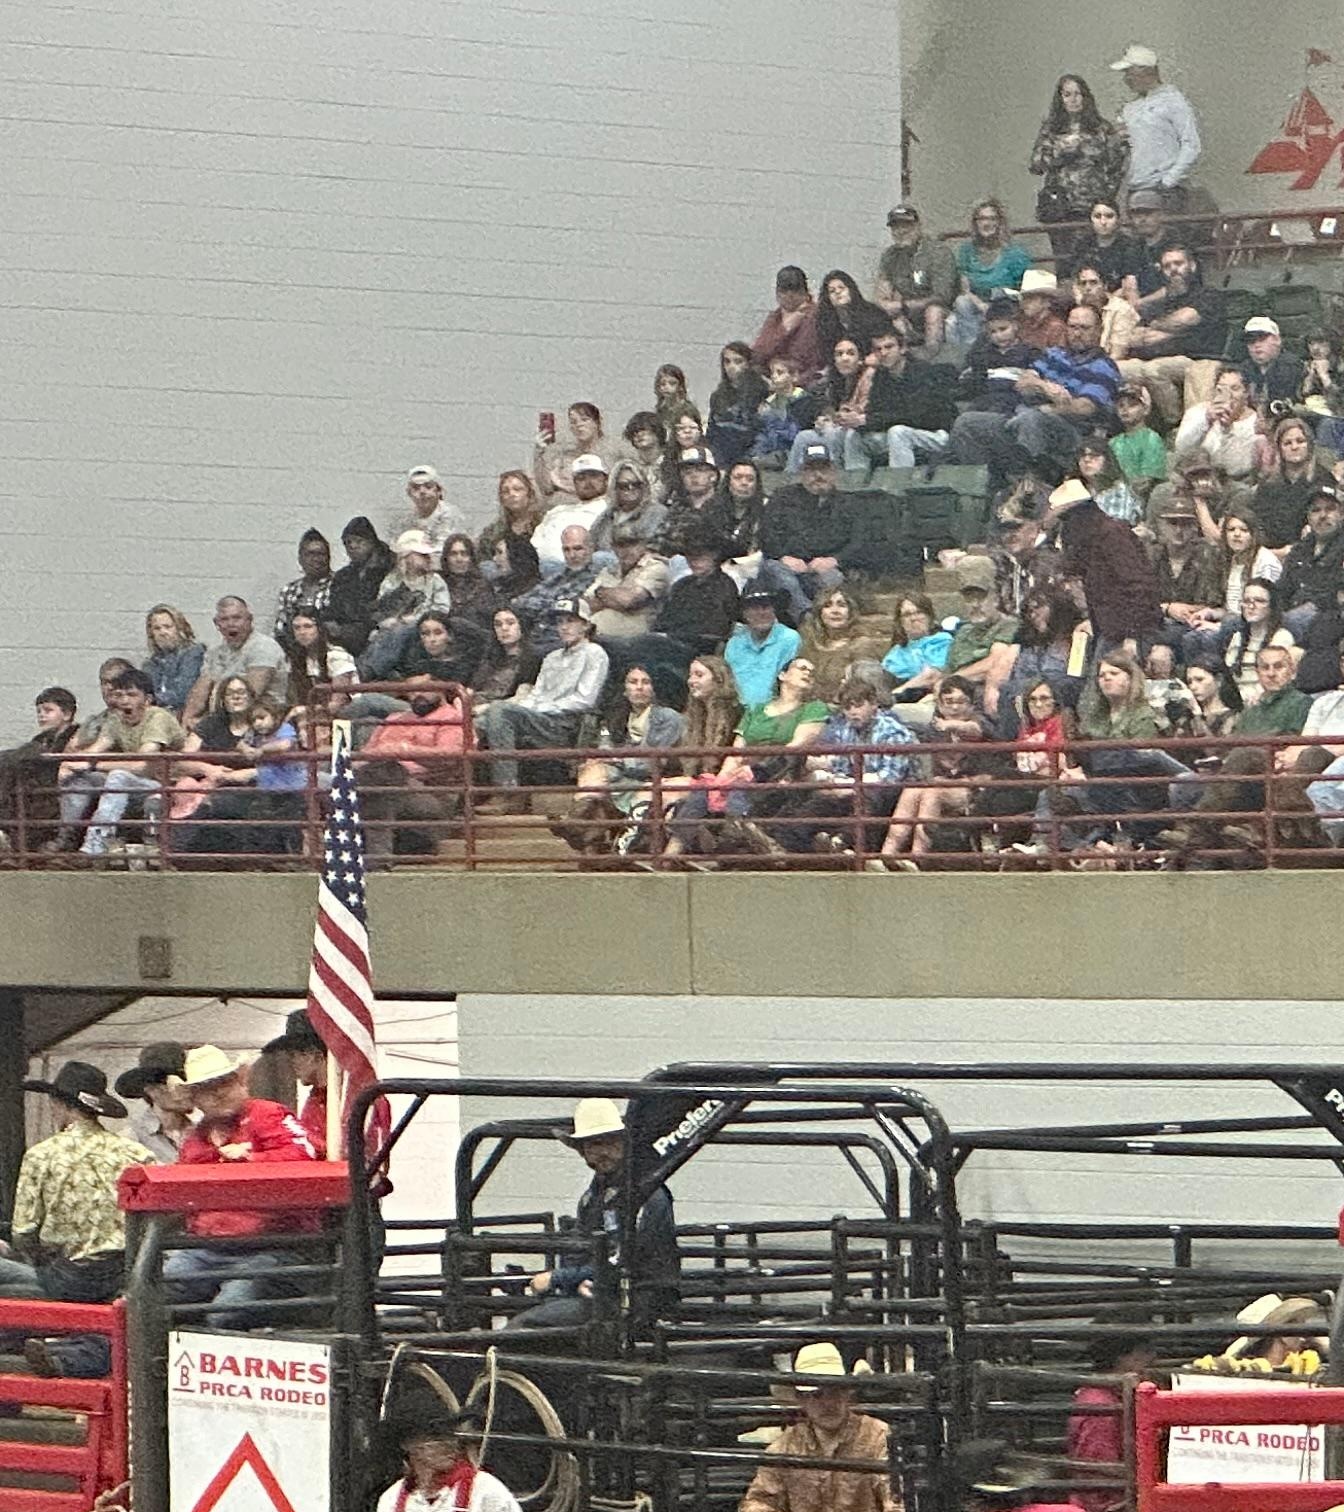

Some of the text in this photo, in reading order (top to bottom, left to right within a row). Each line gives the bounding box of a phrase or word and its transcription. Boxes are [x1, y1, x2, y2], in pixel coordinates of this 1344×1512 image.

[180, 1364, 190, 1387] B
[199, 1352, 328, 1384] BARNES
[199, 1381, 326, 1406] PRCA RODEO
[1200, 1428, 1320, 1452] PRCA RODEO
